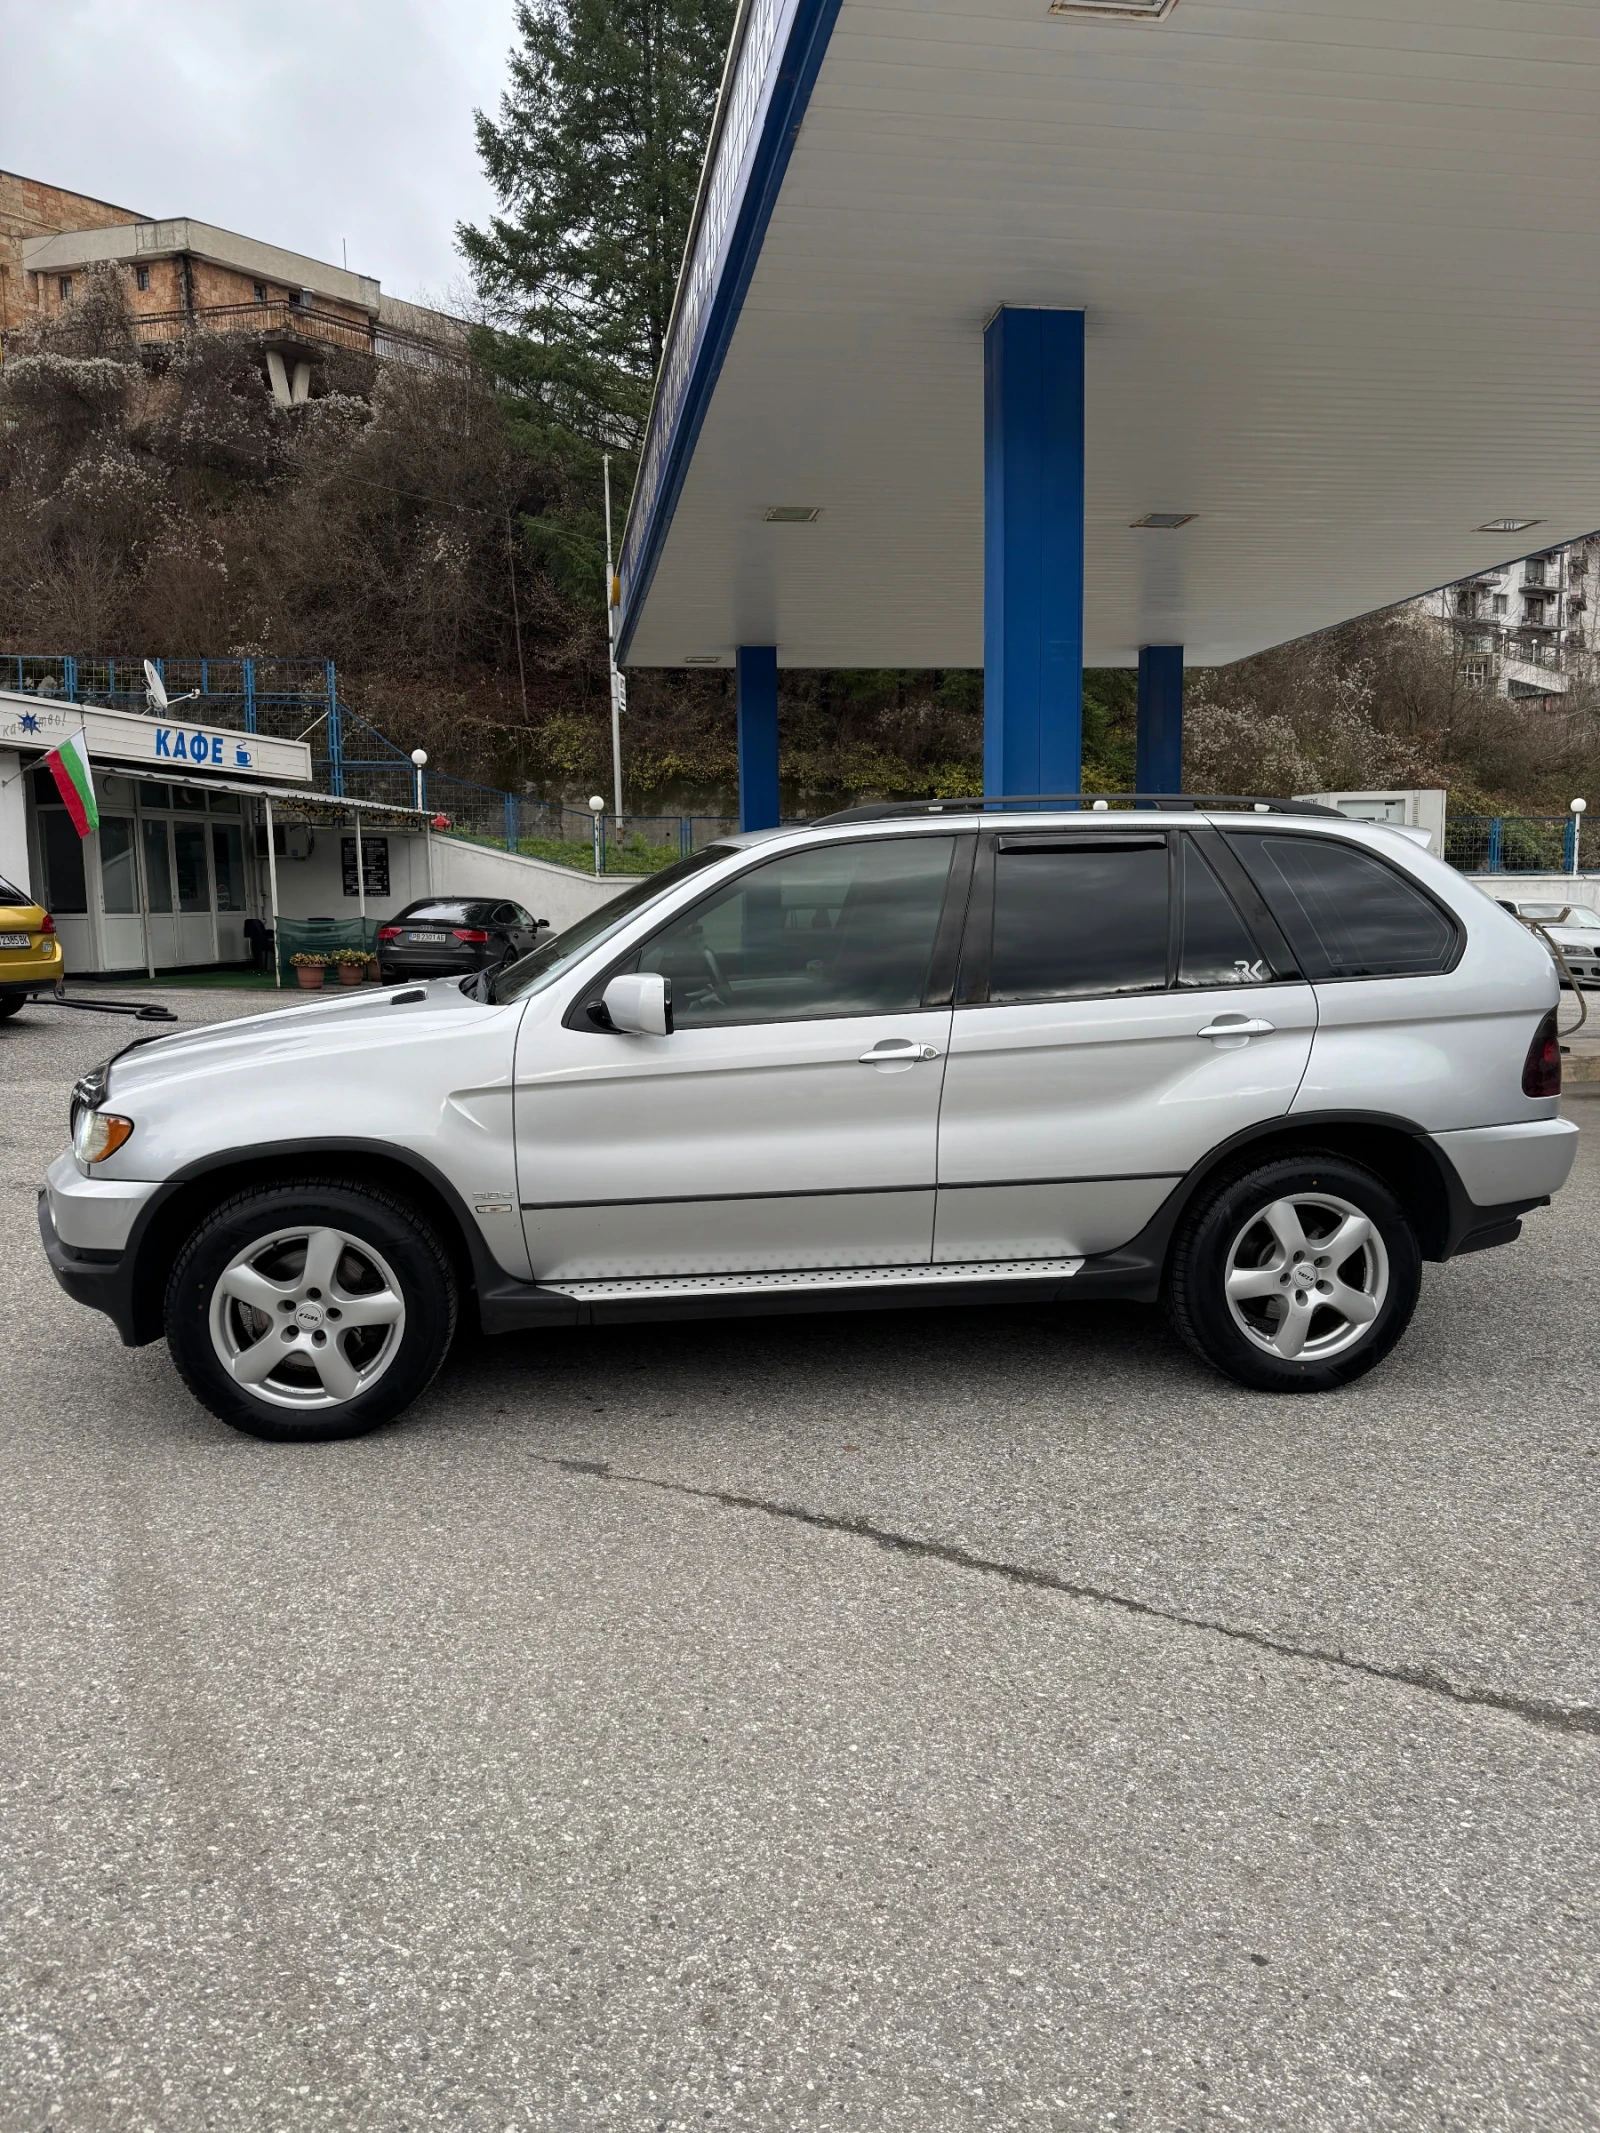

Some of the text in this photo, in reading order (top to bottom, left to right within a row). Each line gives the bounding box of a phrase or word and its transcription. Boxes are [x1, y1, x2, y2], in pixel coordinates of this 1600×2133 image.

[3, 711, 66, 737] катво!
[155, 728, 224, 764] КАФЕ
[0, 935, 30, 945] 2385BK
